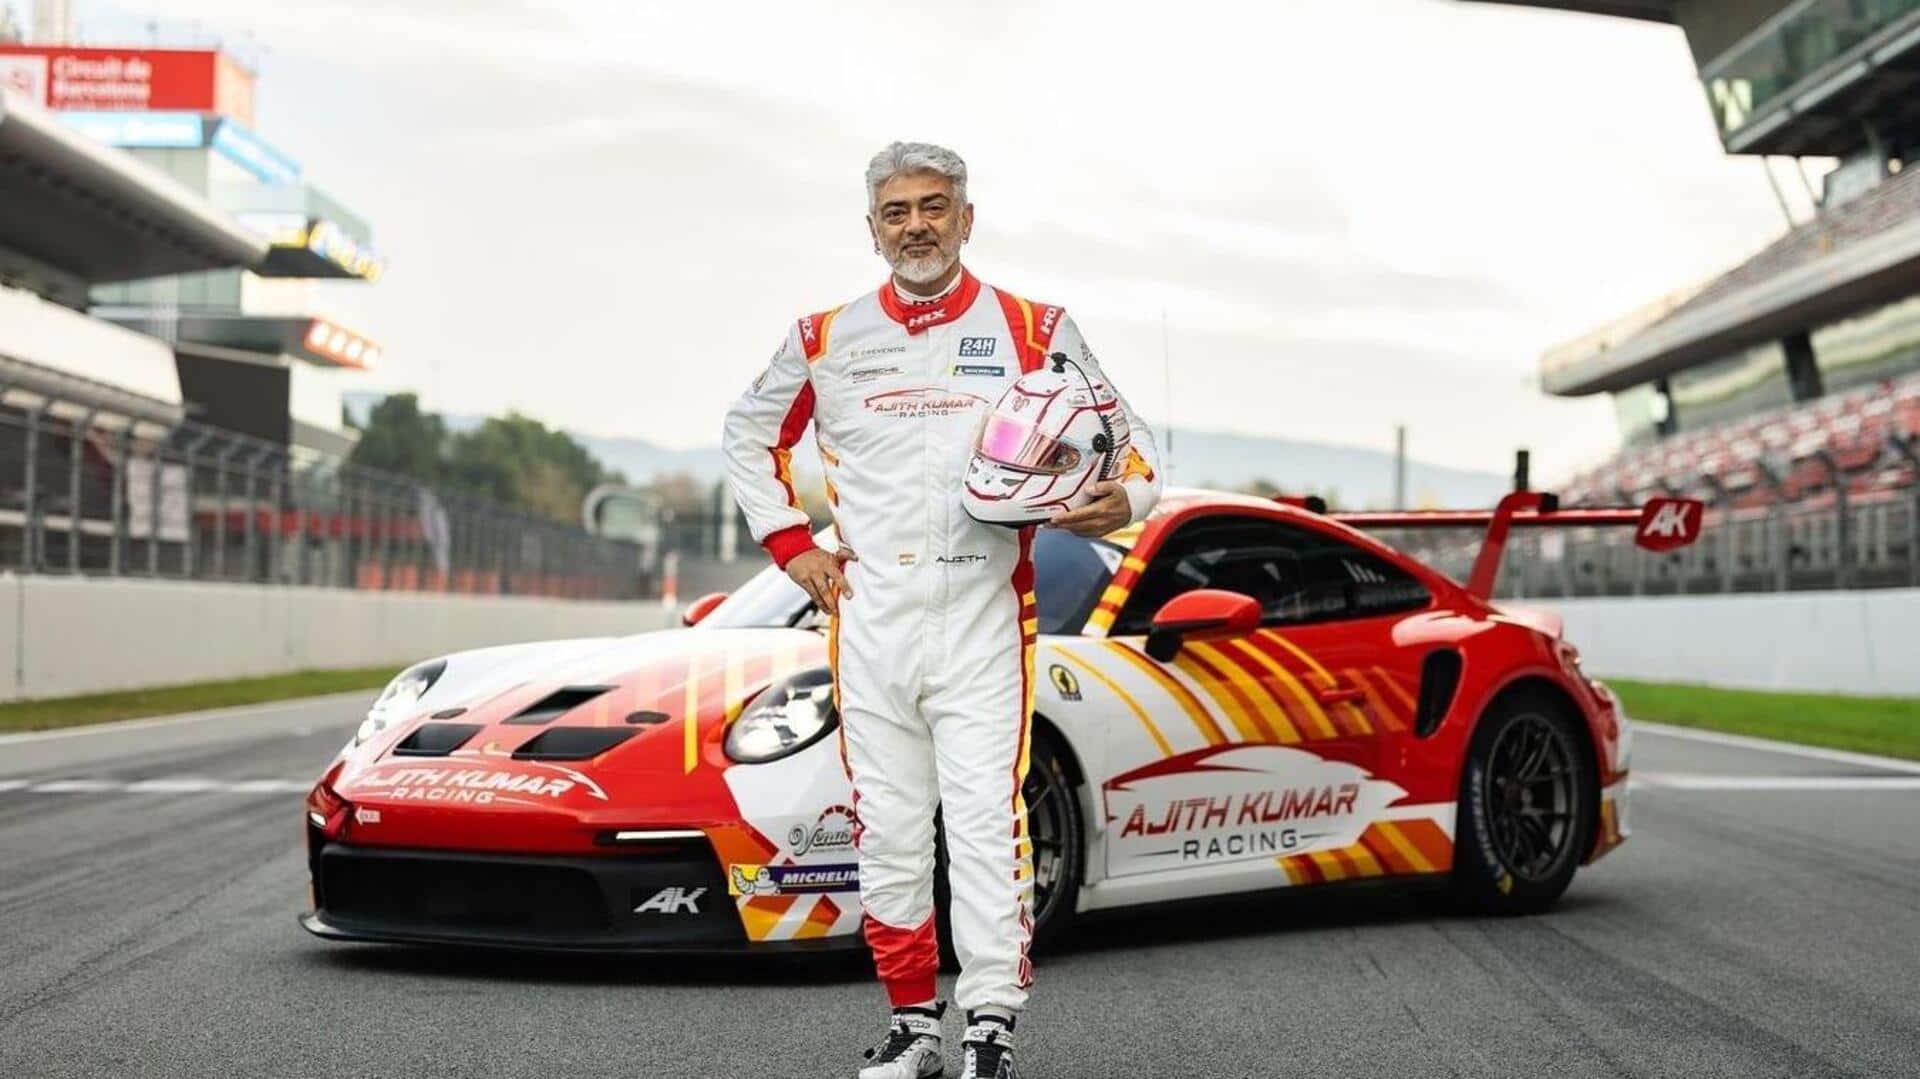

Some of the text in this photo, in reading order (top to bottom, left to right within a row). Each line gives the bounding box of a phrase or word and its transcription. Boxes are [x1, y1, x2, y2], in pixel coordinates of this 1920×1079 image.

[908, 308, 947, 328] HRX
[962, 338, 994, 350] 24H
[874, 398, 975, 412] AJITH KUMAR
[899, 409, 949, 419] RACING
[1642, 502, 1691, 537] AK
[935, 554, 987, 564] AJITH
[352, 768, 576, 798] AJITH KUMAR
[389, 786, 497, 805] RACING
[1120, 783, 1360, 838] AJITH KUMAR
[788, 823, 853, 857] Venus
[1182, 828, 1298, 861] RACING
[633, 886, 708, 914] AK
